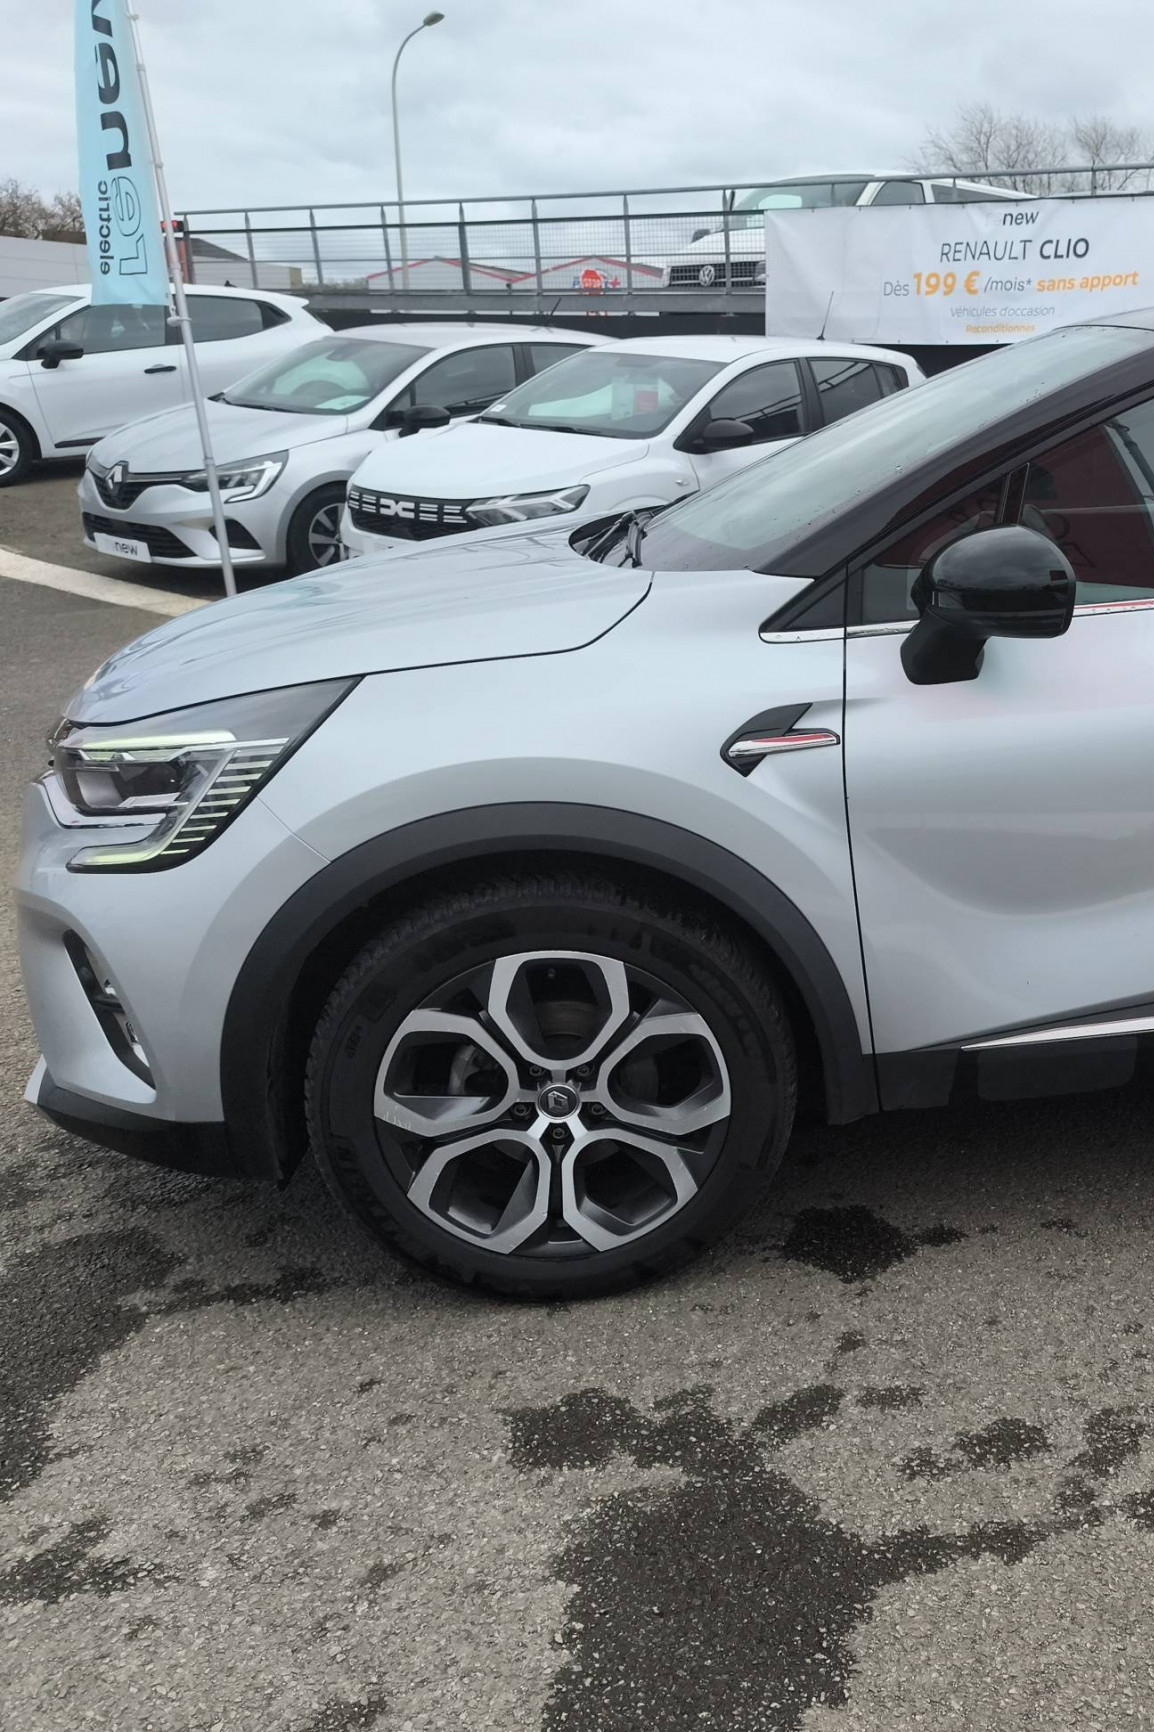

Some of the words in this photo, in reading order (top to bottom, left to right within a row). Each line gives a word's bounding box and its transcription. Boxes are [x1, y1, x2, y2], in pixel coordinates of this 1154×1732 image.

[940, 240, 1033, 263] RENAULT
[1039, 238, 1090, 260] CLIO
[883, 281, 910, 297] Dès
[913, 272, 957, 297] 199
[964, 270, 982, 296] €
[1036, 278, 1076, 292] sans
[1080, 271, 1139, 292] apport
